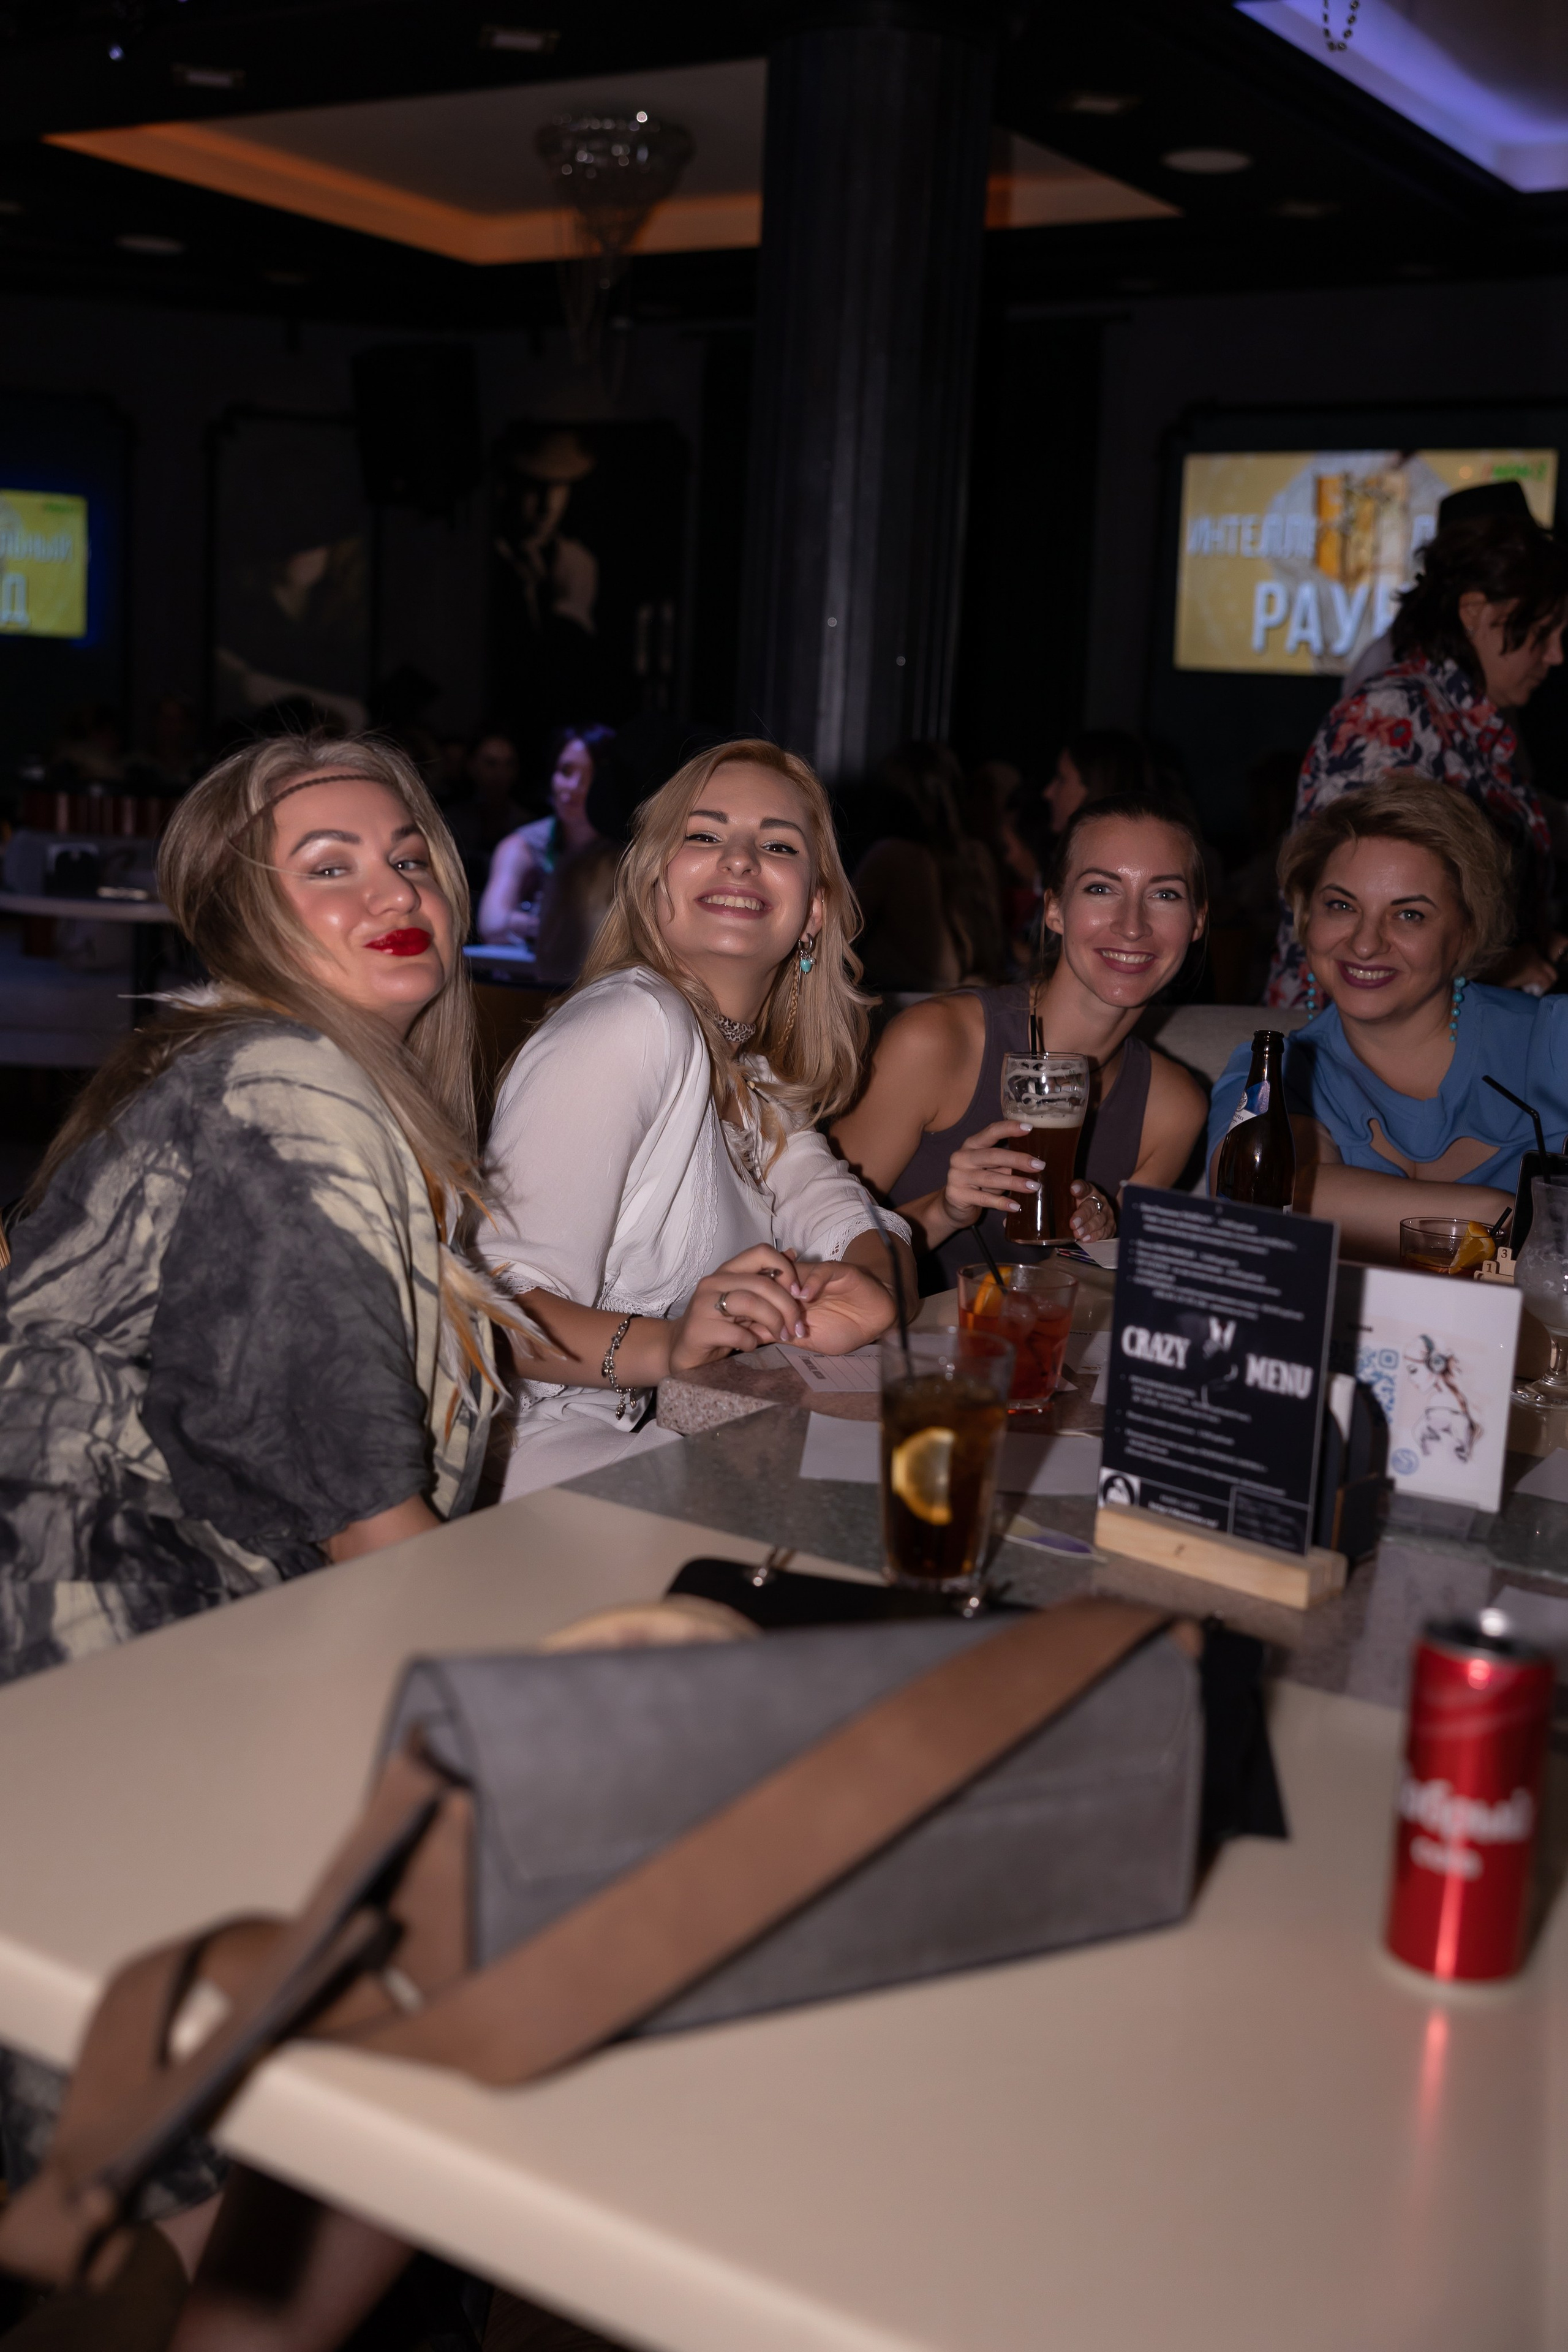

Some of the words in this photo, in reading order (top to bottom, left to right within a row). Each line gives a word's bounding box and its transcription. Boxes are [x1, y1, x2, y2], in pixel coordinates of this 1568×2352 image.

[1252, 581, 1403, 657] РАУ
[1486, 1263, 1493, 1273] 1
[1501, 1249, 1508, 1259] 3
[1121, 1325, 1191, 1370] CRAZY
[1245, 1352, 1314, 1400] MENU
